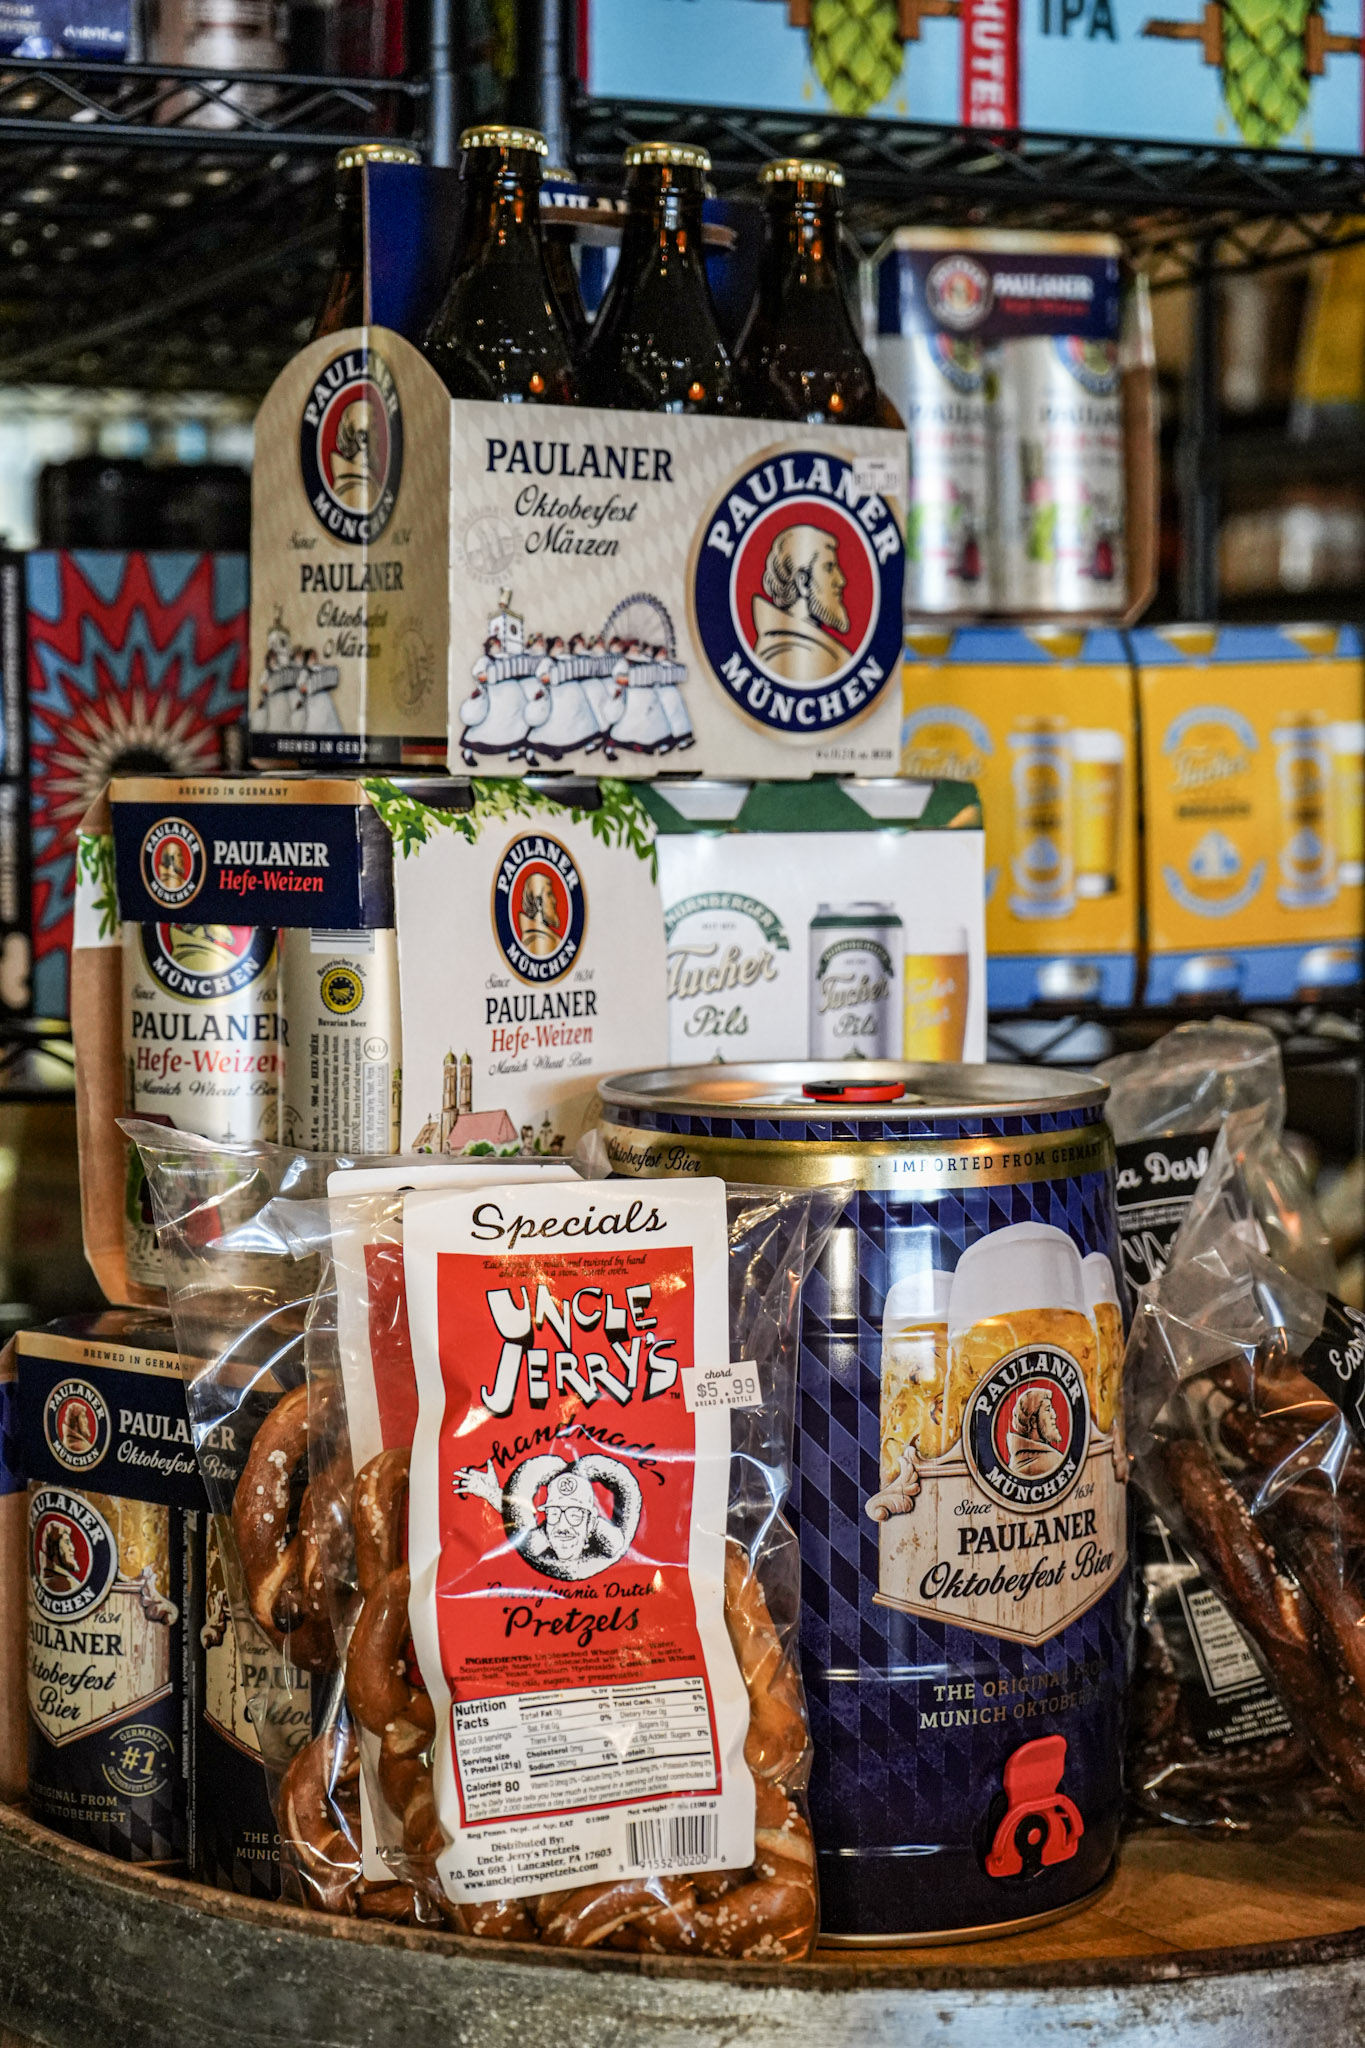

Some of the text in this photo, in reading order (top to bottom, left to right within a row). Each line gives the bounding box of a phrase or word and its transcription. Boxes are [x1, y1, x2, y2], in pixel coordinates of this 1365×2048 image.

[1040, 0, 1118, 42] IPA
[485, 438, 674, 482] PAULANER
[514, 484, 638, 526] Oktoberfest
[706, 457, 900, 565] PAULANER
[524, 523, 620, 556] Märzen
[300, 561, 404, 594] PAULANER
[720, 651, 886, 726] MÜNCHEN
[178, 786, 289, 797] BREWED IN GERMANY
[145, 822, 200, 855] PAULANER
[212, 839, 330, 868] PAULANER
[497, 837, 579, 894] PAULANER
[218, 869, 324, 896] Hefe-Weizen
[506, 939, 578, 979] MÜNCHEN
[667, 943, 778, 1001] Tucher
[152, 956, 260, 996] MÜNCHEN
[818, 972, 891, 1014] Tucher
[485, 989, 598, 1025] PAULANER
[131, 1010, 290, 1047] PAULANER
[684, 1004, 749, 1038] Pils
[832, 1011, 879, 1037] Pils
[491, 1021, 593, 1059] Hefe-Weizen
[136, 1047, 286, 1080] Hefe-Weizen
[607, 1135, 702, 1172] Oktoberfest Bier
[893, 1155, 994, 1173] IMPORTED
[1002, 1151, 1047, 1168] FROM
[470, 1199, 668, 1250] Specials
[583, 1254, 648, 1267] twisted hand
[486, 1283, 659, 1352] UNCLE
[83, 1347, 126, 1363] BREWED
[129, 1355, 142, 1365] IN
[480, 1331, 679, 1419] JERRY'S
[704, 1367, 733, 1379] chord
[975, 1353, 1082, 1416] PAULANER
[48, 1382, 106, 1421] PAULANER
[695, 1395, 753, 1407] BREAD BOTTLE
[696, 1377, 756, 1399] $5.99
[51, 1440, 101, 1467] MÜNCHEN
[486, 1413, 664, 1480] handmade
[116, 1439, 239, 1482] Oktoberfest Bier
[984, 1458, 1078, 1502] MÜNCHEN
[1073, 1481, 1095, 1500] 1634
[953, 1498, 993, 1516] Since
[957, 1508, 1098, 1556] PAULANER
[919, 1541, 1115, 1602] Oktoberfest Bier
[603, 1582, 656, 1599] Dutch
[92, 1611, 122, 1625] 1634
[502, 1605, 640, 1648] Pretzels
[465, 1655, 532, 1666] INGREDIENTS:
[933, 1669, 1069, 1702] THE ORIGINAL
[37, 1685, 82, 1722] Bier
[455, 1699, 507, 1717] Nutrition
[540, 1709, 553, 1718] Fat
[613, 1698, 653, 1708] Total Carb.
[456, 1717, 489, 1731] Facts
[599, 1714, 612, 1722] 0%
[637, 1720, 660, 1730] Sugars
[919, 1704, 1008, 1730] MUNICH
[484, 1731, 512, 1742] servings
[696, 1729, 709, 1737] 0%
[119, 1745, 156, 1776] #1
[462, 1753, 511, 1767] Serving size
[472, 1743, 502, 1753] container
[526, 1746, 568, 1759] Cholesterol
[471, 1760, 522, 1775] Pretzel (21g)
[528, 1761, 555, 1772] Sodium
[466, 1779, 520, 1793] Calories 80
[80, 1793, 118, 1807] FROM
[627, 1808, 642, 1816] Net
[641, 1803, 668, 1815] weight
[558, 1819, 574, 1829] EAT
[243, 1831, 270, 1845] THE
[490, 1835, 566, 1853] Distributed By:
[449, 1847, 613, 1881] P.O. Box 695 Lancaster, PA 17603
[476, 1844, 581, 1866] Uncle Jerry's Pretzels
[676, 1854, 709, 1868] 00200
[463, 1862, 600, 1891] www.unclejerryspretzels.com
